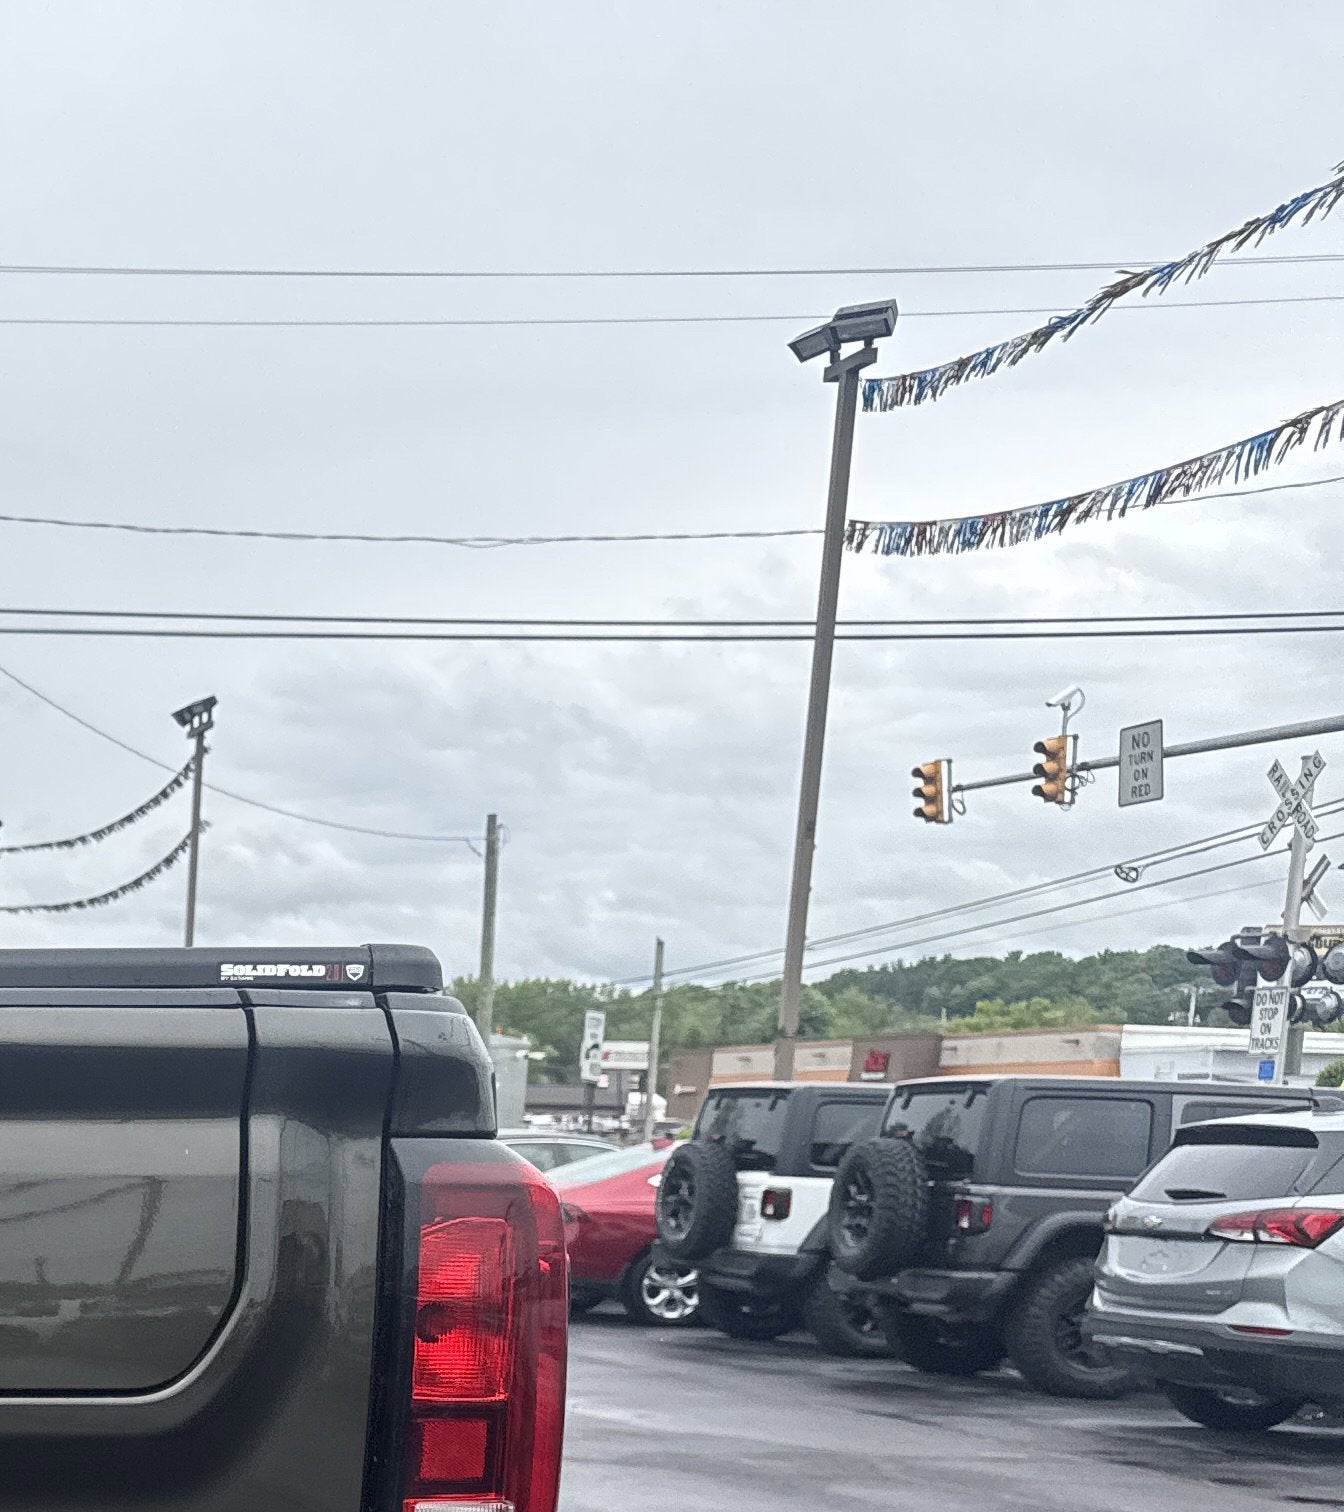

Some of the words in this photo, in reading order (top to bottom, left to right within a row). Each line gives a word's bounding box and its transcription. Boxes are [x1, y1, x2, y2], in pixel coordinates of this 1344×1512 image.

[1131, 731, 1151, 750] NO
[1128, 750, 1155, 766] TURN
[1133, 767, 1149, 782] ON
[1131, 783, 1152, 799] RED
[1260, 756, 1322, 845] CROSSING
[1256, 992, 1268, 1006] DO
[1268, 990, 1284, 1006] NOT
[1259, 1007, 1279, 1021] STOP
[1259, 1022, 1272, 1036] ON
